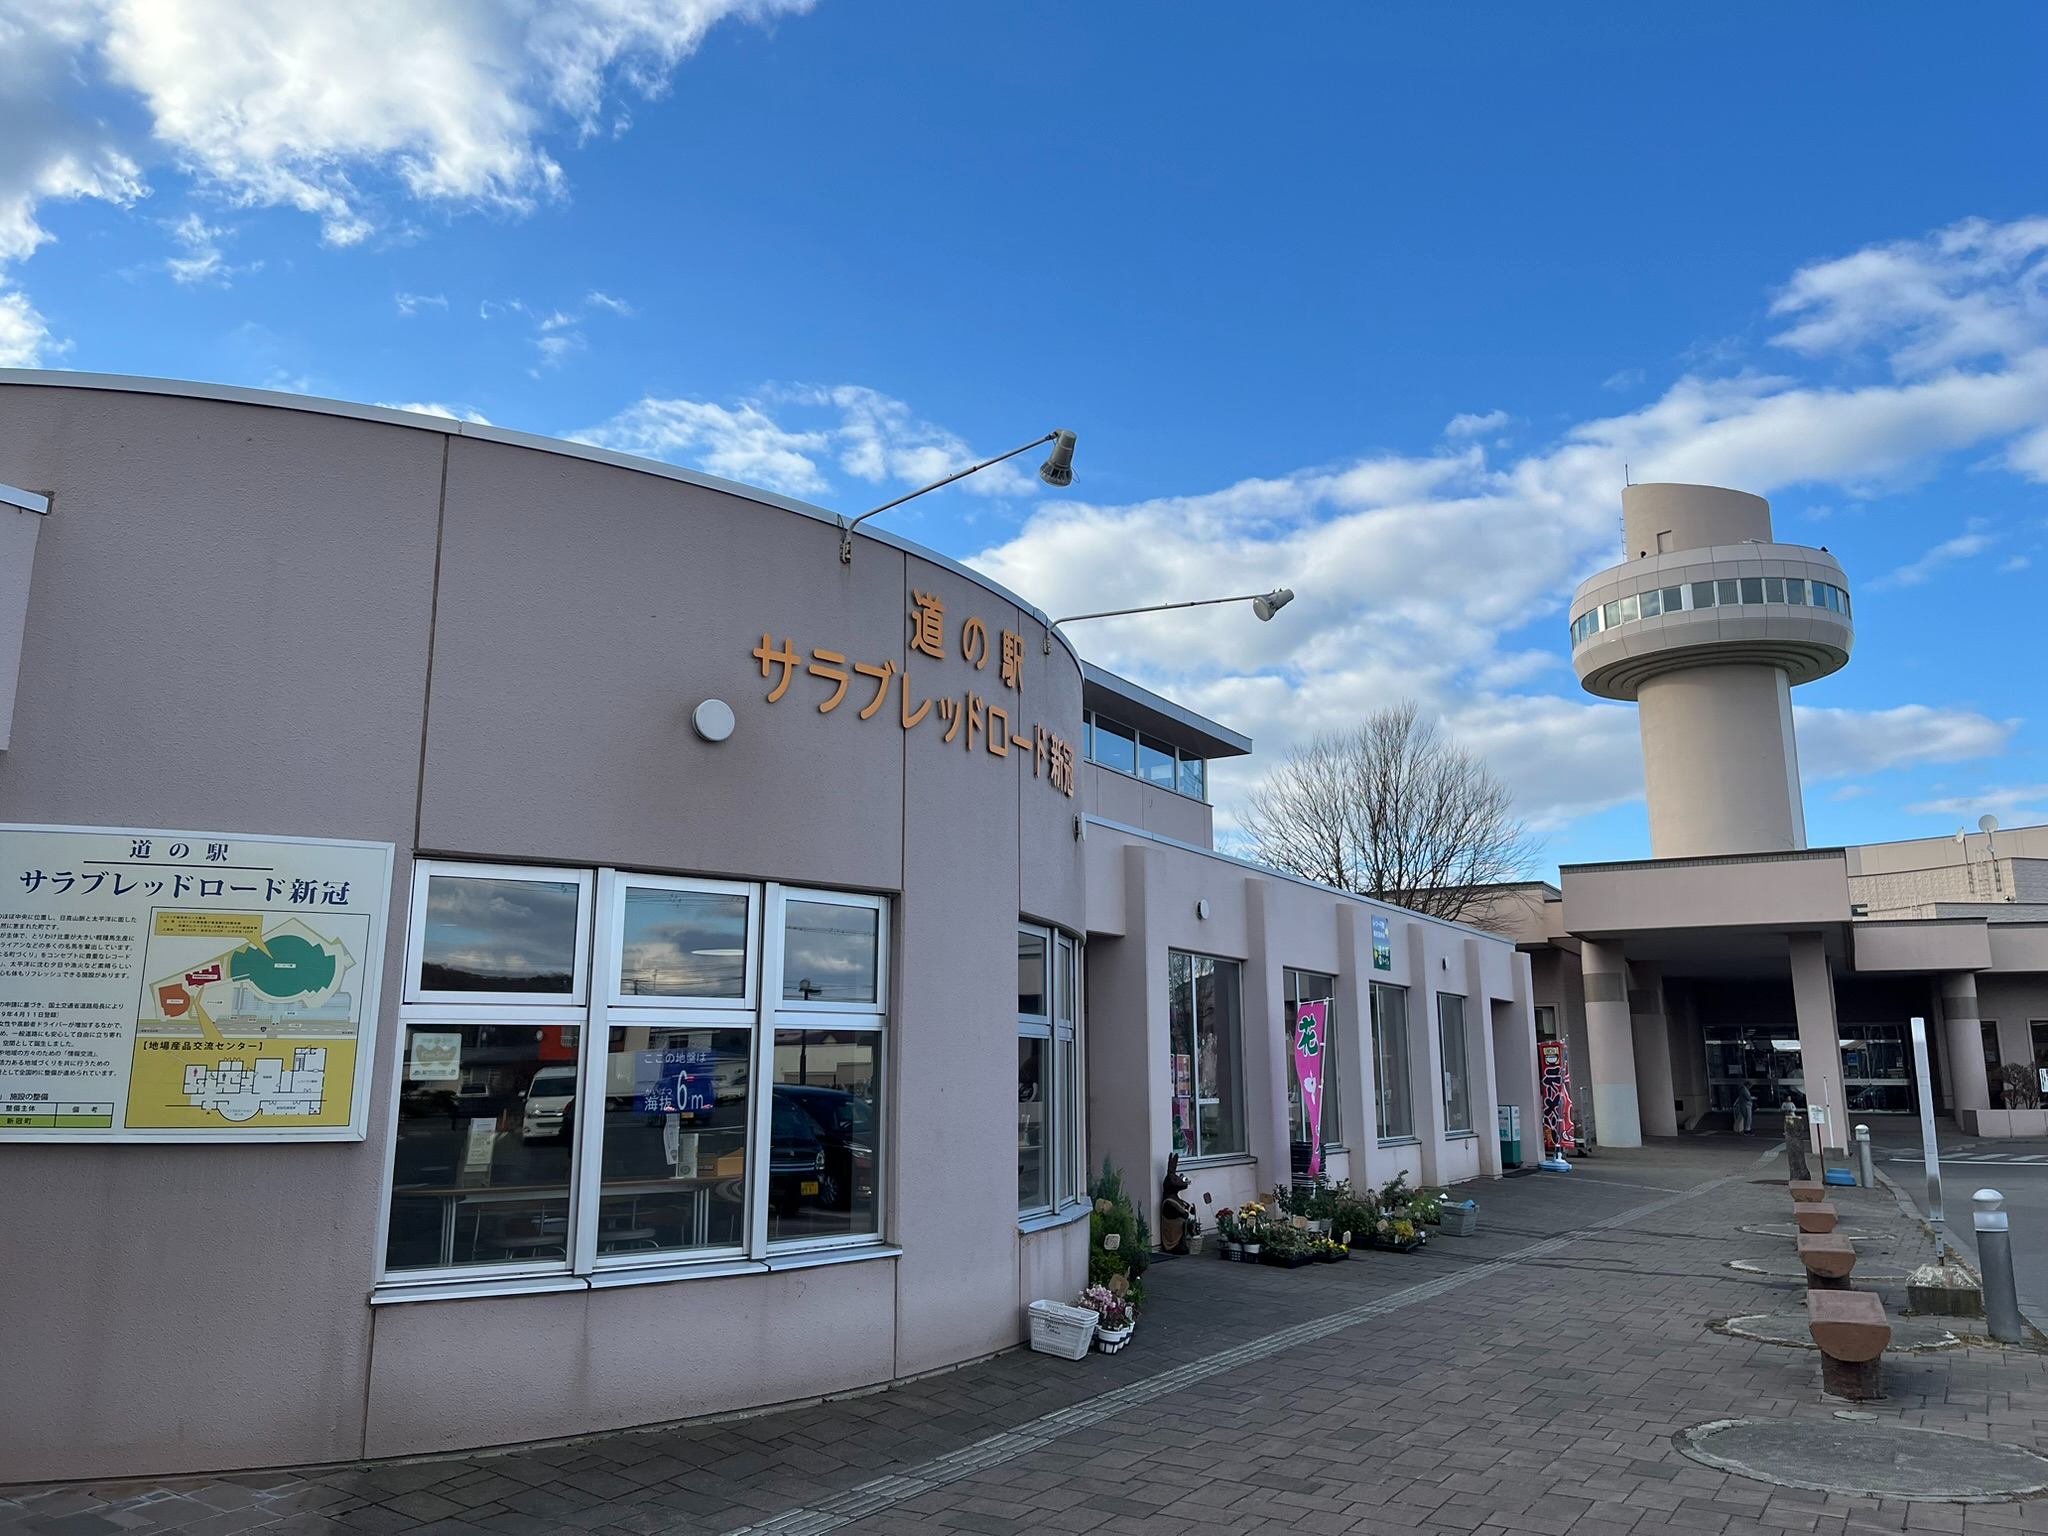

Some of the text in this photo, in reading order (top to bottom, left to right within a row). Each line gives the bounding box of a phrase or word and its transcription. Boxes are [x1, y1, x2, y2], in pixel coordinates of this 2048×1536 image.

[911, 588, 1025, 693] 道の駅
[753, 632, 1075, 798] サラブレッドロード新冠
[129, 839, 229, 862] 道の駅
[20, 870, 350, 905] サラブレッドロード新冠
[142, 1040, 264, 1051] 【地場産品交流センター】
[1298, 1013, 1319, 1057] 花
[644, 1052, 706, 1063] ここの地盤は
